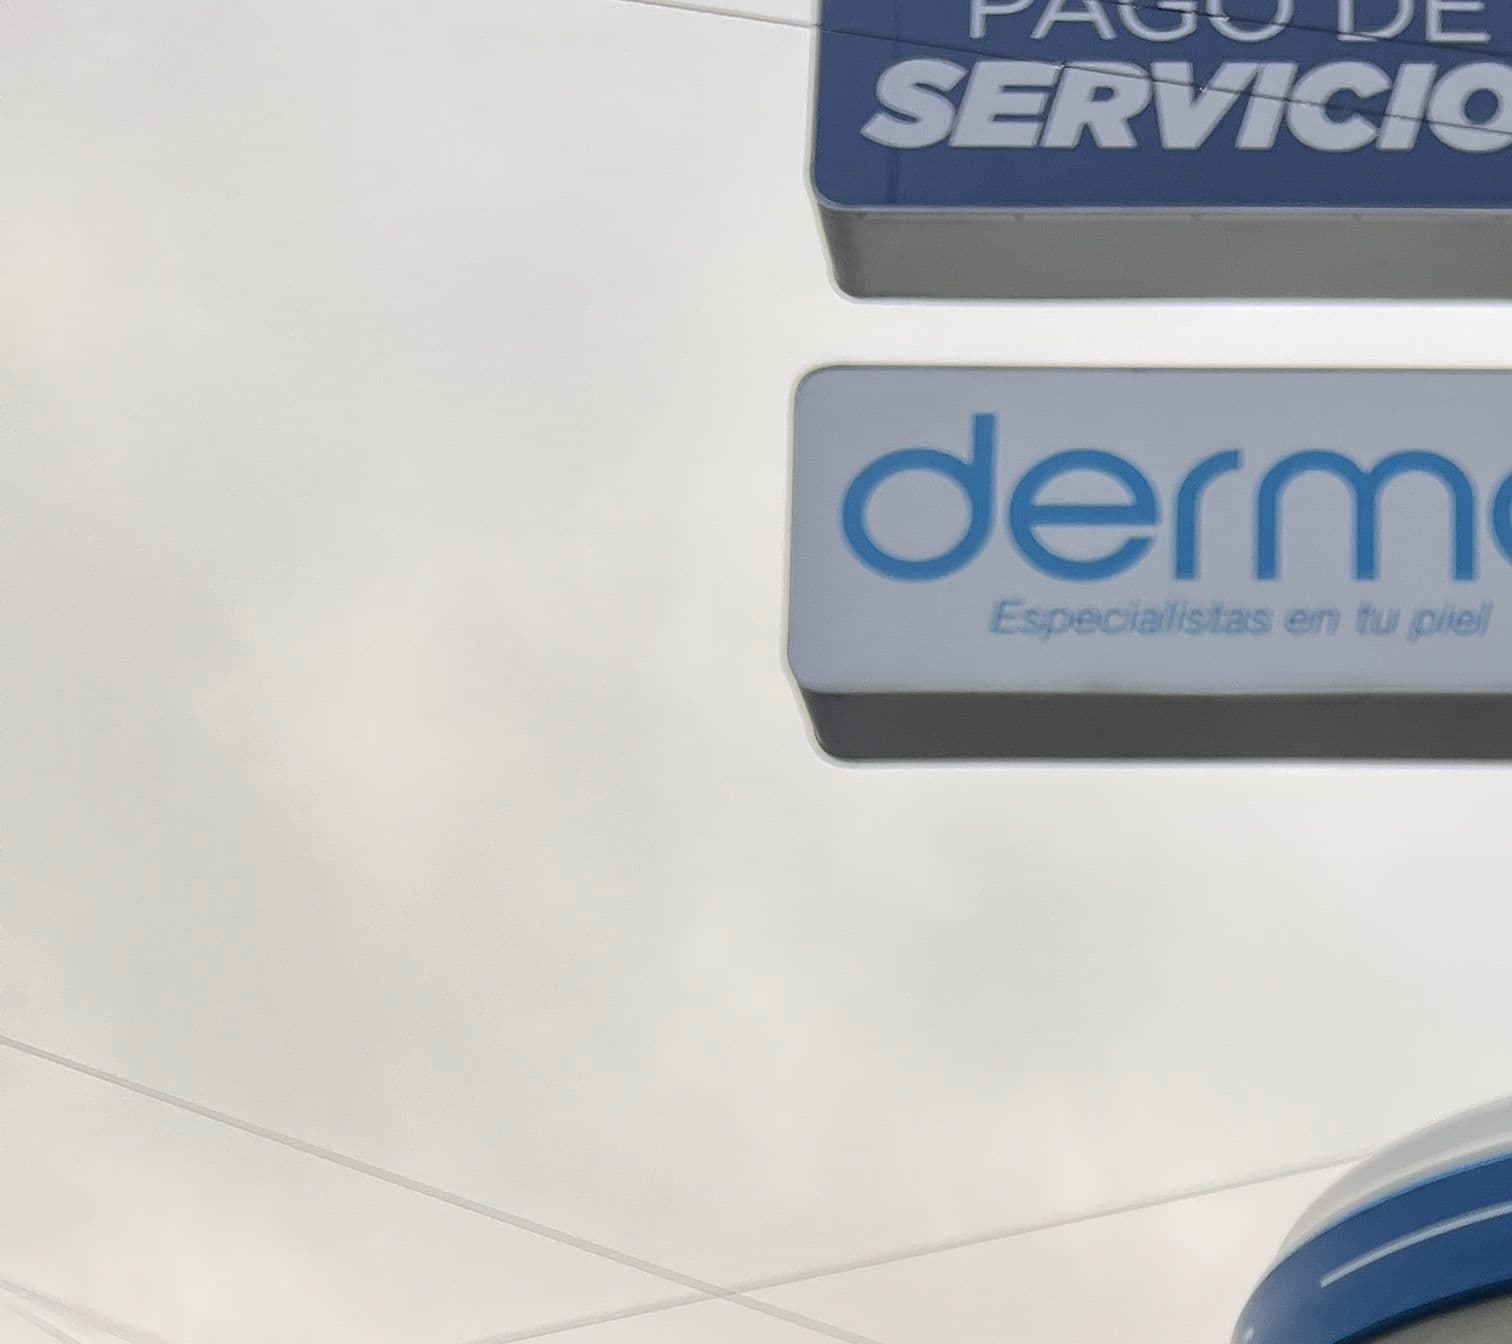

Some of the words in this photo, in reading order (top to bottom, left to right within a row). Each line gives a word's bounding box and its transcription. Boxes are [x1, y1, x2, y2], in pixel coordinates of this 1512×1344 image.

[969, 0, 1295, 42] PAGO
[1336, 0, 1492, 43] DE
[989, 599, 1274, 640] Especialistas
[1283, 605, 1341, 636] en
[1354, 600, 1398, 636] tu
[1408, 600, 1494, 642] piel
